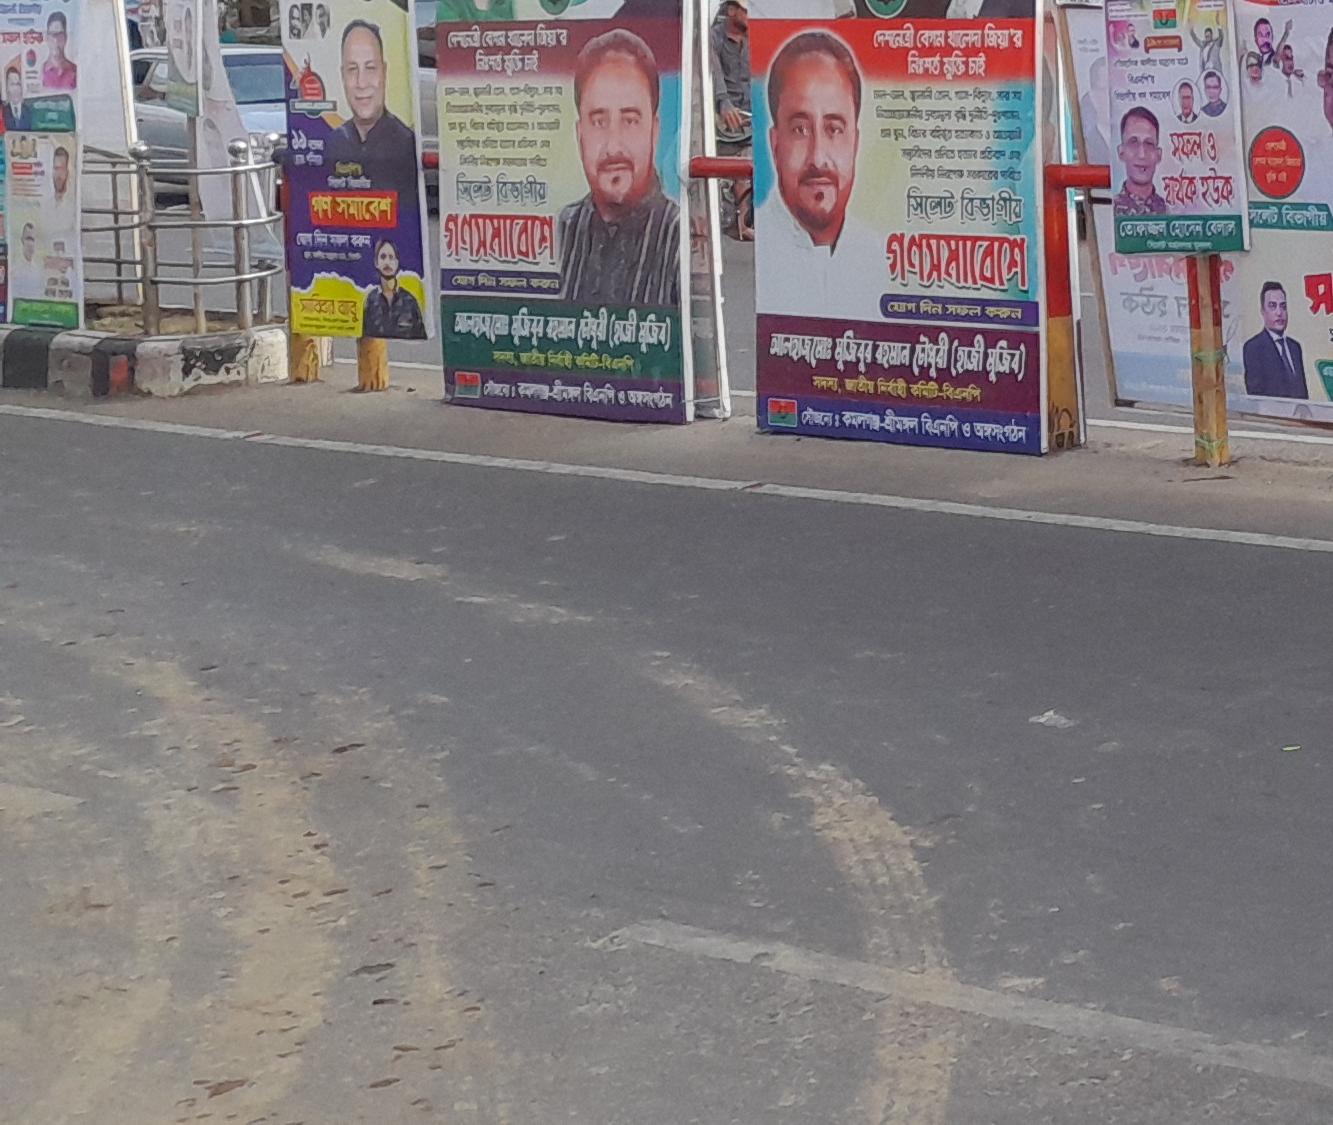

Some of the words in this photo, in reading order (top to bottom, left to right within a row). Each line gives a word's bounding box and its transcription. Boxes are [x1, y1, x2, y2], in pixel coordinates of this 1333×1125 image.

[943, 51, 965, 80] মুক্তি
[968, 52, 986, 76] চাই
[456, 172, 492, 205] সিলেট
[496, 173, 547, 205] বিভাগীয়
[907, 187, 954, 222] সিলেট
[960, 188, 1023, 225] বিভাগীয়
[312, 195, 333, 219] গণ
[335, 196, 392, 221] সমাবেশ
[445, 214, 554, 264] গণসমাবেশে
[886, 233, 1028, 291] গণসমাবেশে
